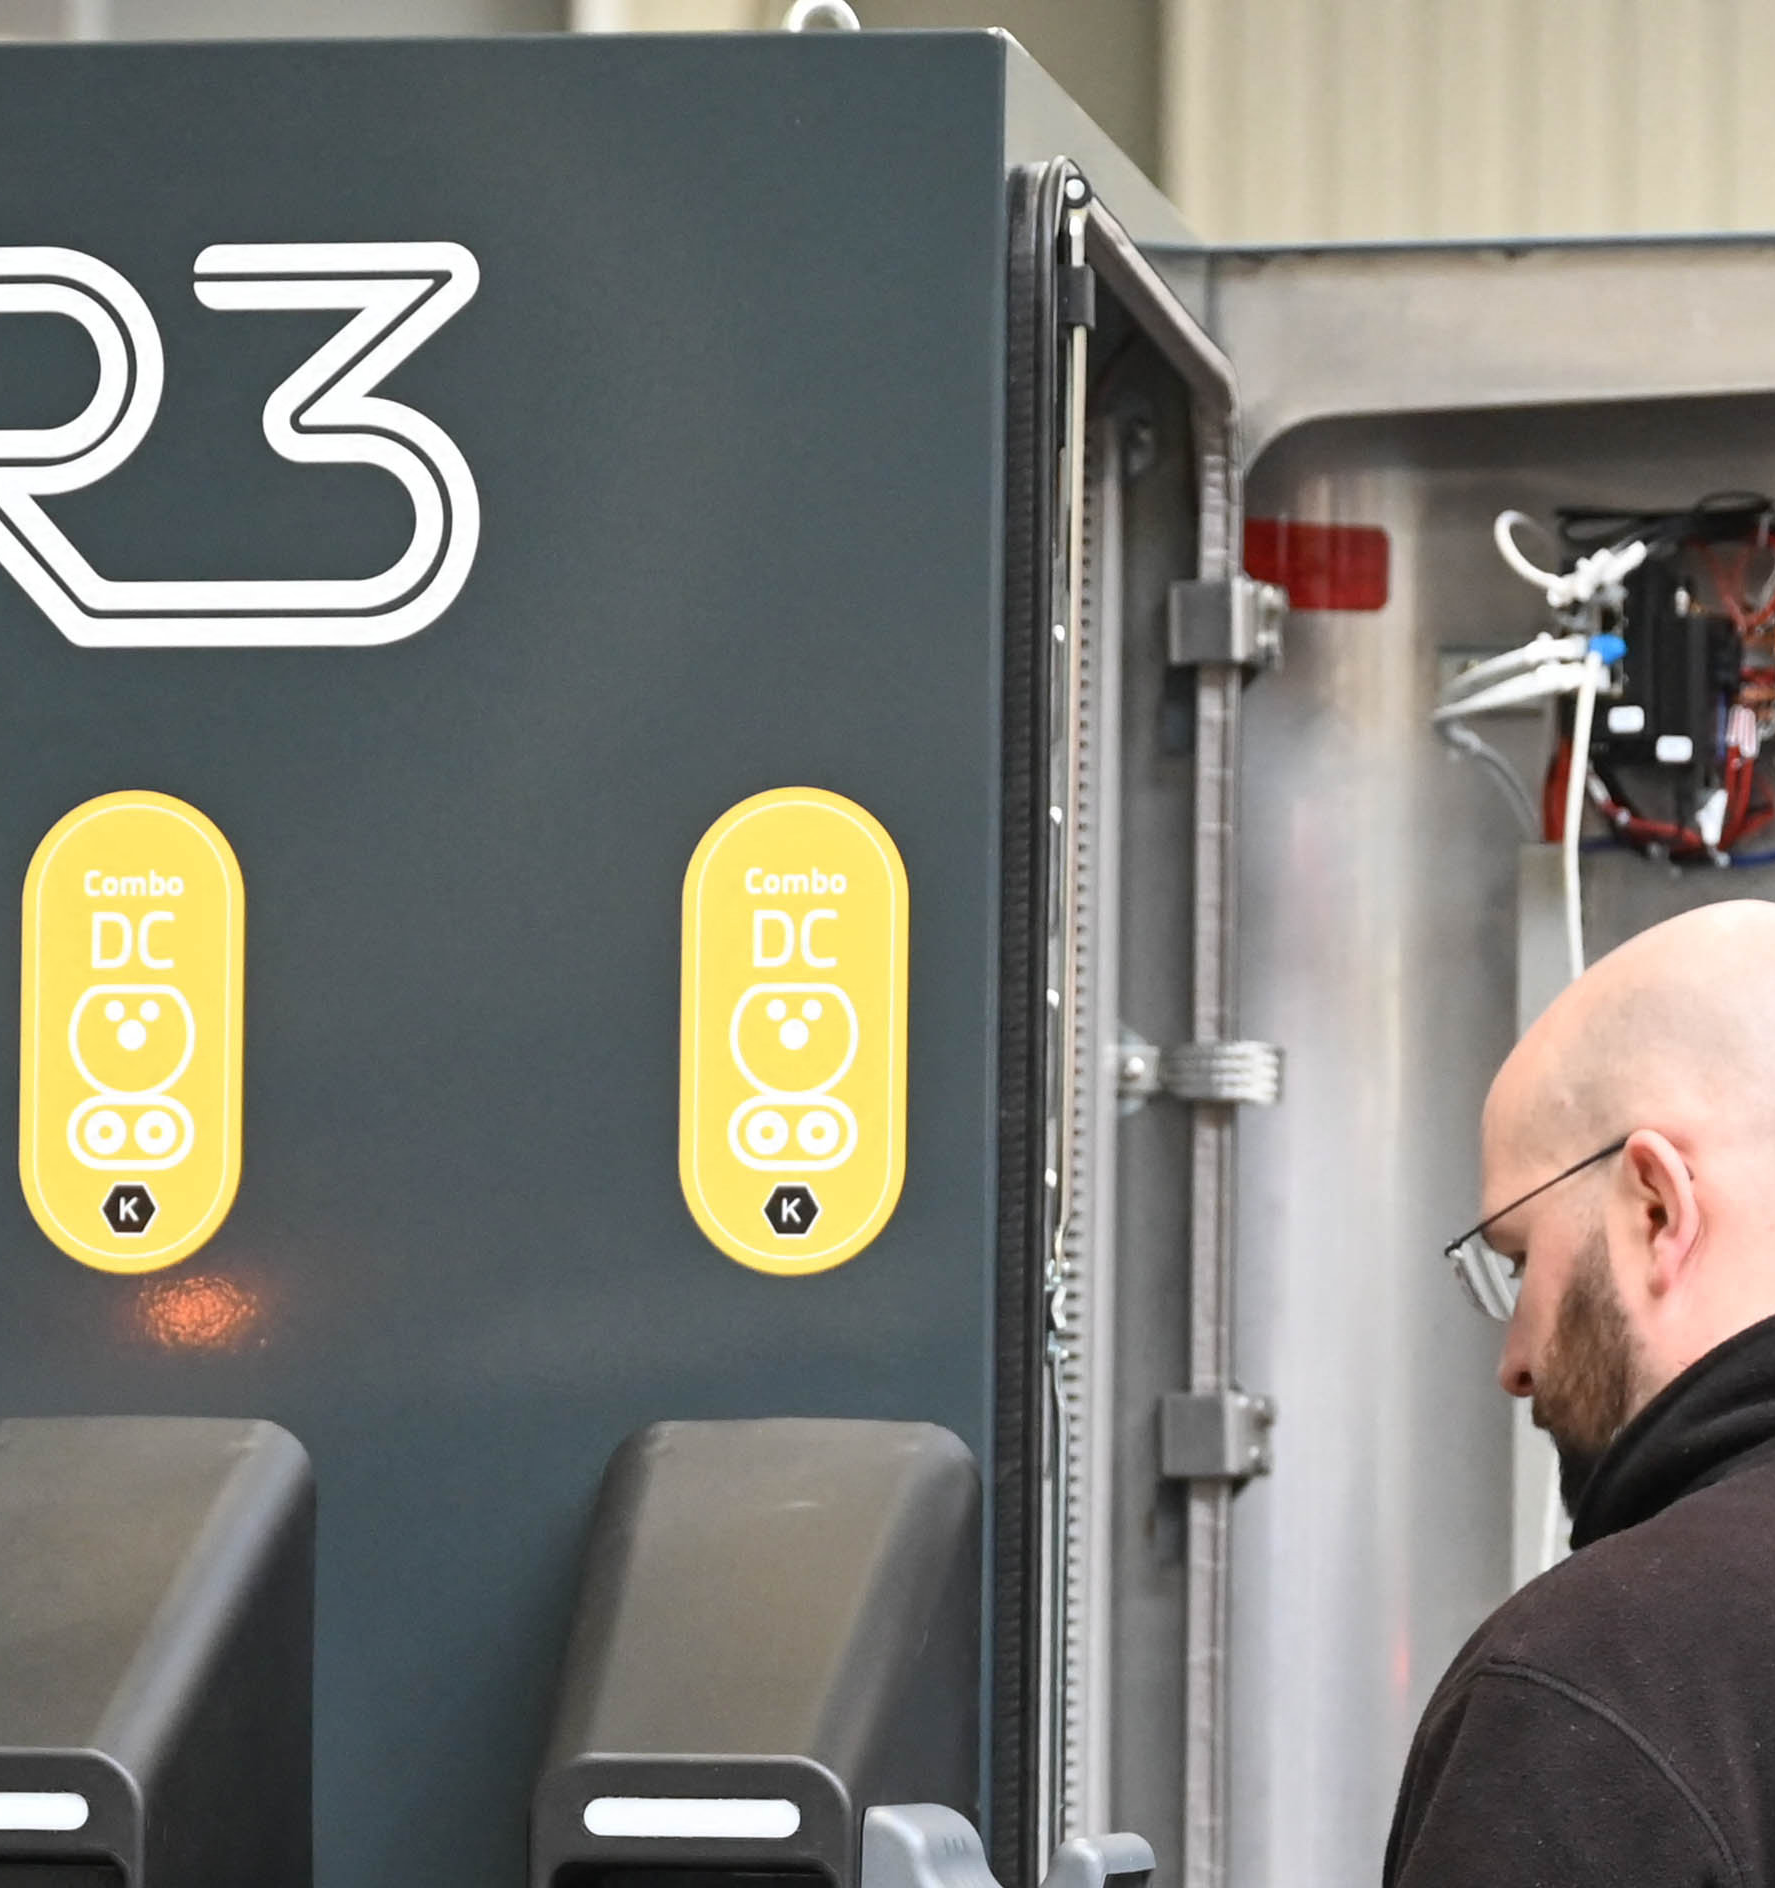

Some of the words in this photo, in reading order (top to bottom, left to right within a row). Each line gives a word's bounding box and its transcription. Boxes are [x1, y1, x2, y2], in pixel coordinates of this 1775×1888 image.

[83, 869, 184, 897] Combo
[744, 867, 848, 895] Combo
[91, 910, 175, 969] DC
[752, 908, 838, 968] DC
[119, 1196, 139, 1222] K
[781, 1197, 801, 1223] K
